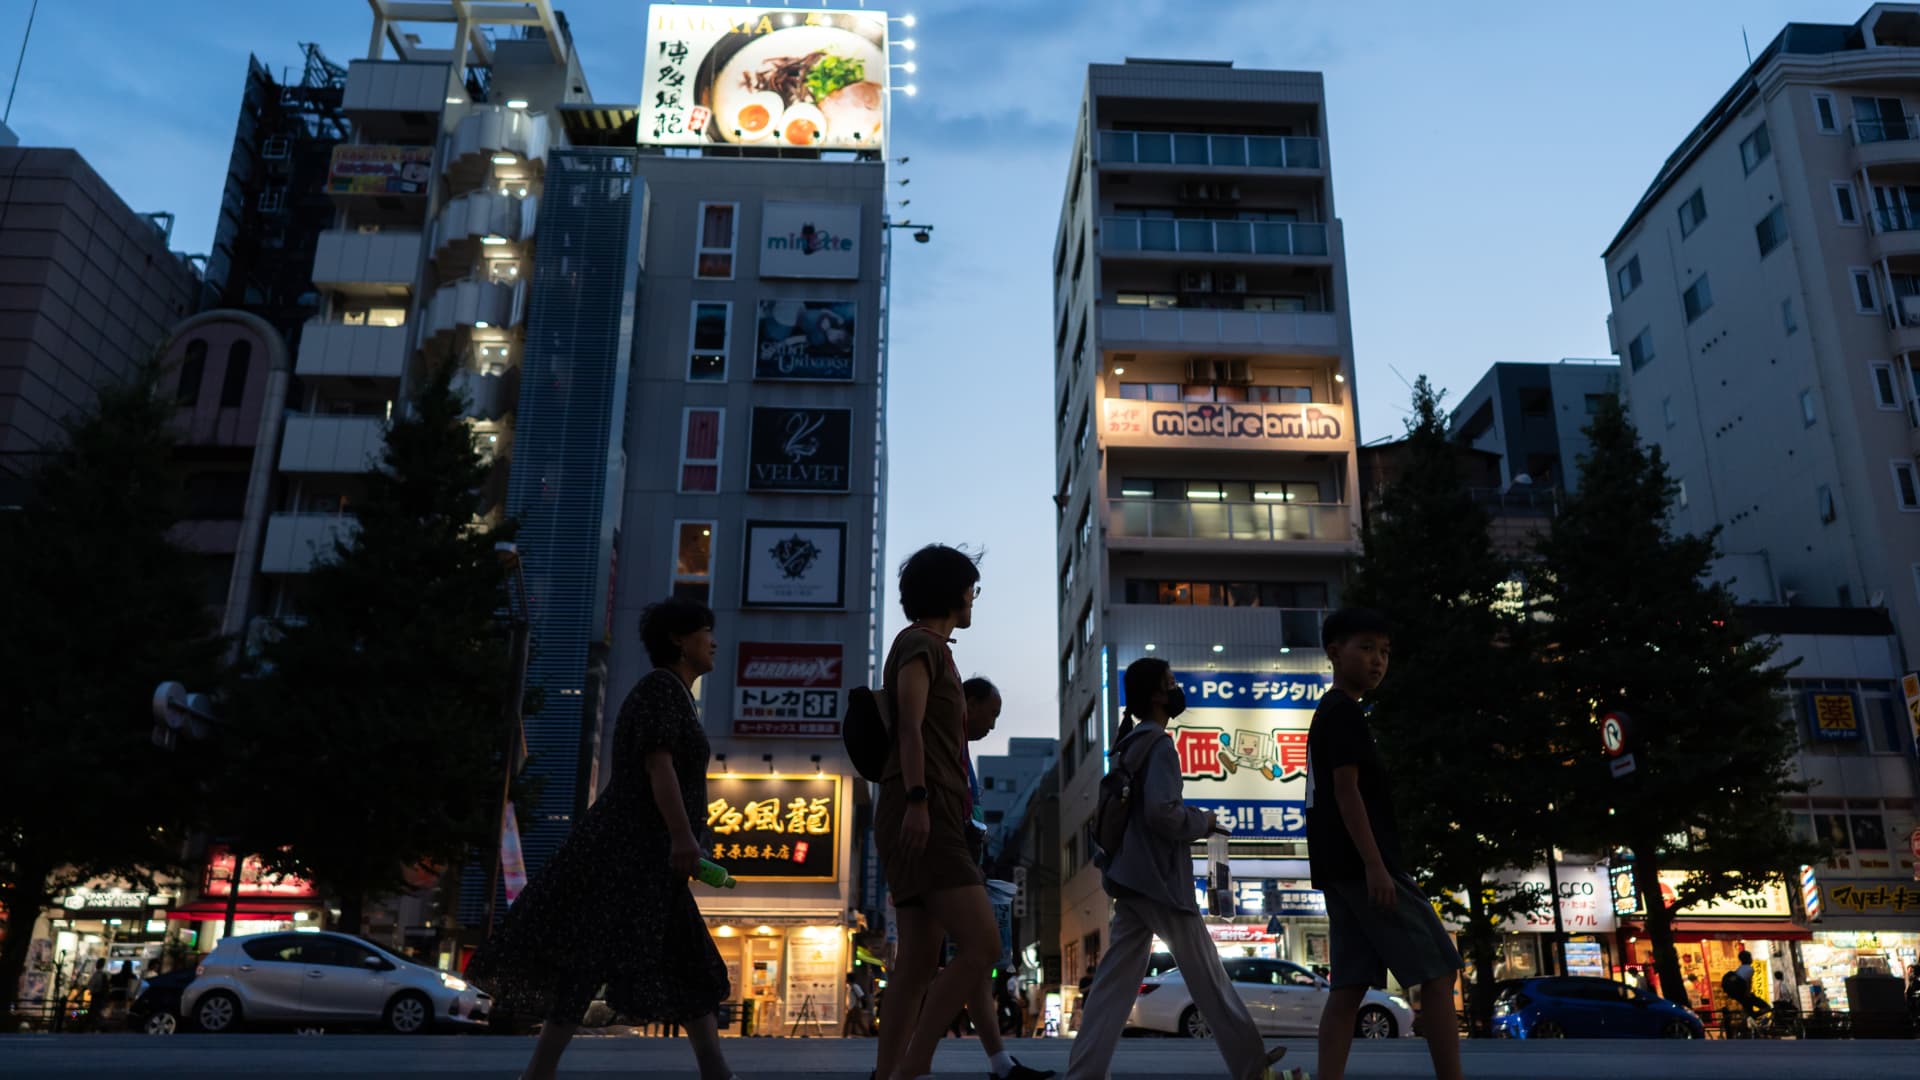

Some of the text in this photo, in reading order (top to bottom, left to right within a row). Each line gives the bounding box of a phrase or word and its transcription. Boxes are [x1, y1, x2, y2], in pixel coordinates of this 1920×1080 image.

[1109, 421, 1141, 432] カフェ
[1153, 405, 1340, 439] maidreamin
[754, 463, 844, 482] VELVET
[742, 690, 801, 705] トレカ
[1182, 681, 1332, 701] ・PC・デジタル
[806, 694, 834, 715] 3F
[1818, 696, 1853, 727] 薬
[1168, 731, 1220, 775] 価
[1199, 806, 1306, 833] も!! 買う
[1512, 881, 1594, 896] TOBCCO
[1527, 915, 1598, 926] コロックル
